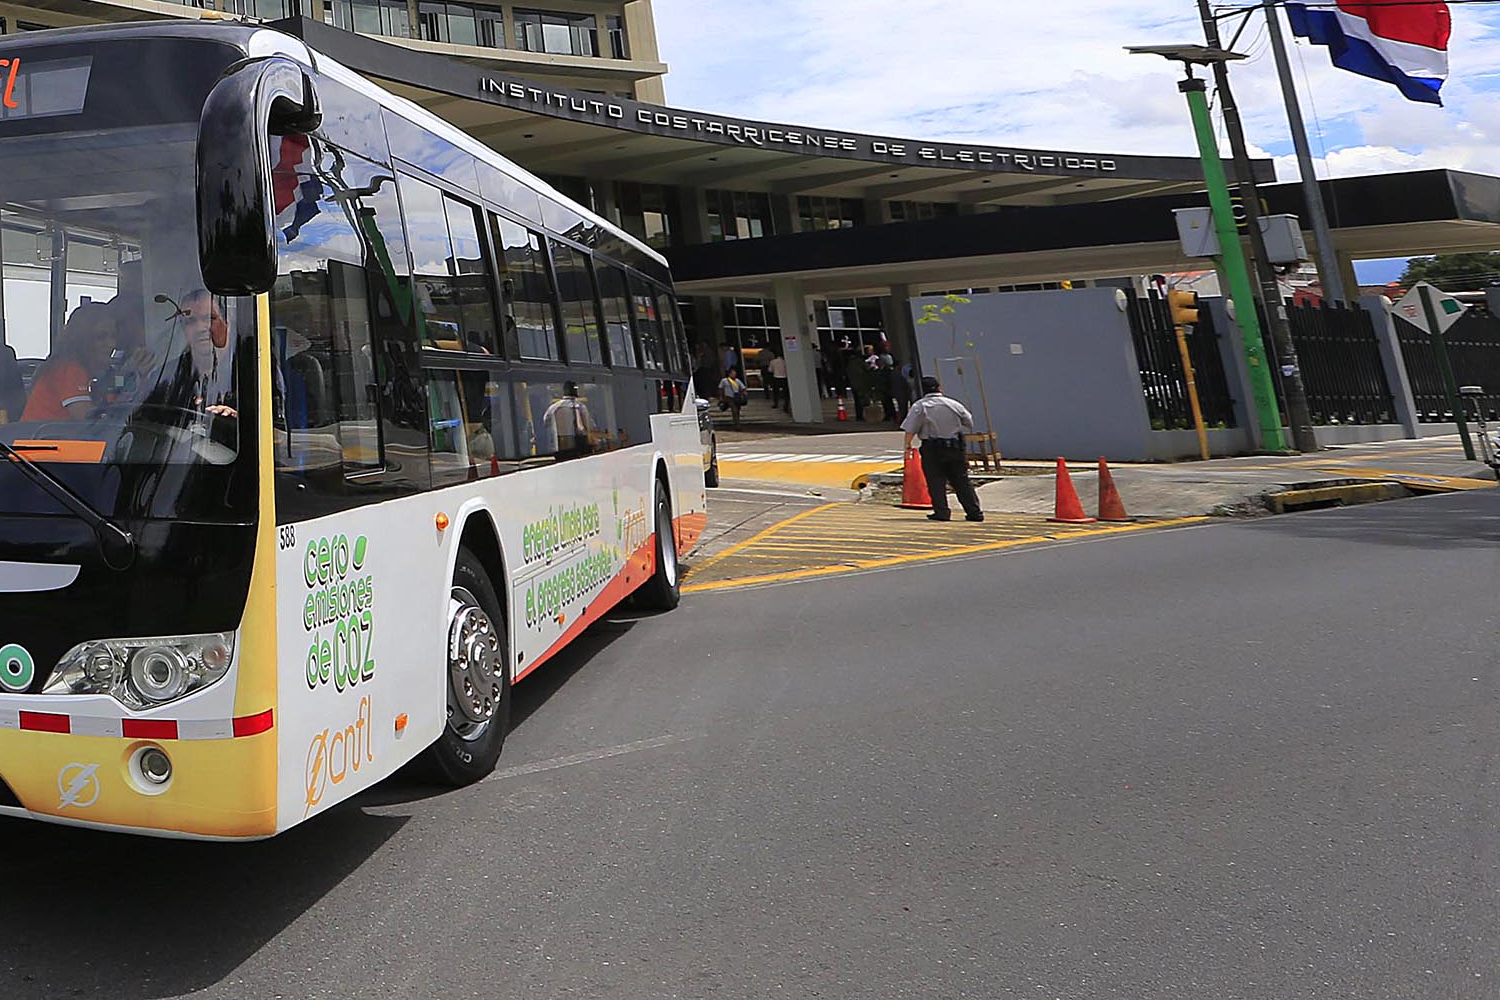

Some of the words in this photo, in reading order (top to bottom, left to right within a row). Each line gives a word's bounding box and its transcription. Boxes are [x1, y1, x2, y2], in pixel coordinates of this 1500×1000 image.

[480, 77, 623, 118] INSTITUTO
[637, 110, 858, 151] COSTARRICENSE
[872, 142, 906, 156] DE
[918, 147, 1117, 170] ELECTRICIDAD
[279, 525, 295, 549] 588
[304, 534, 349, 588] cero
[303, 575, 373, 631] emisiones
[306, 632, 331, 691] de
